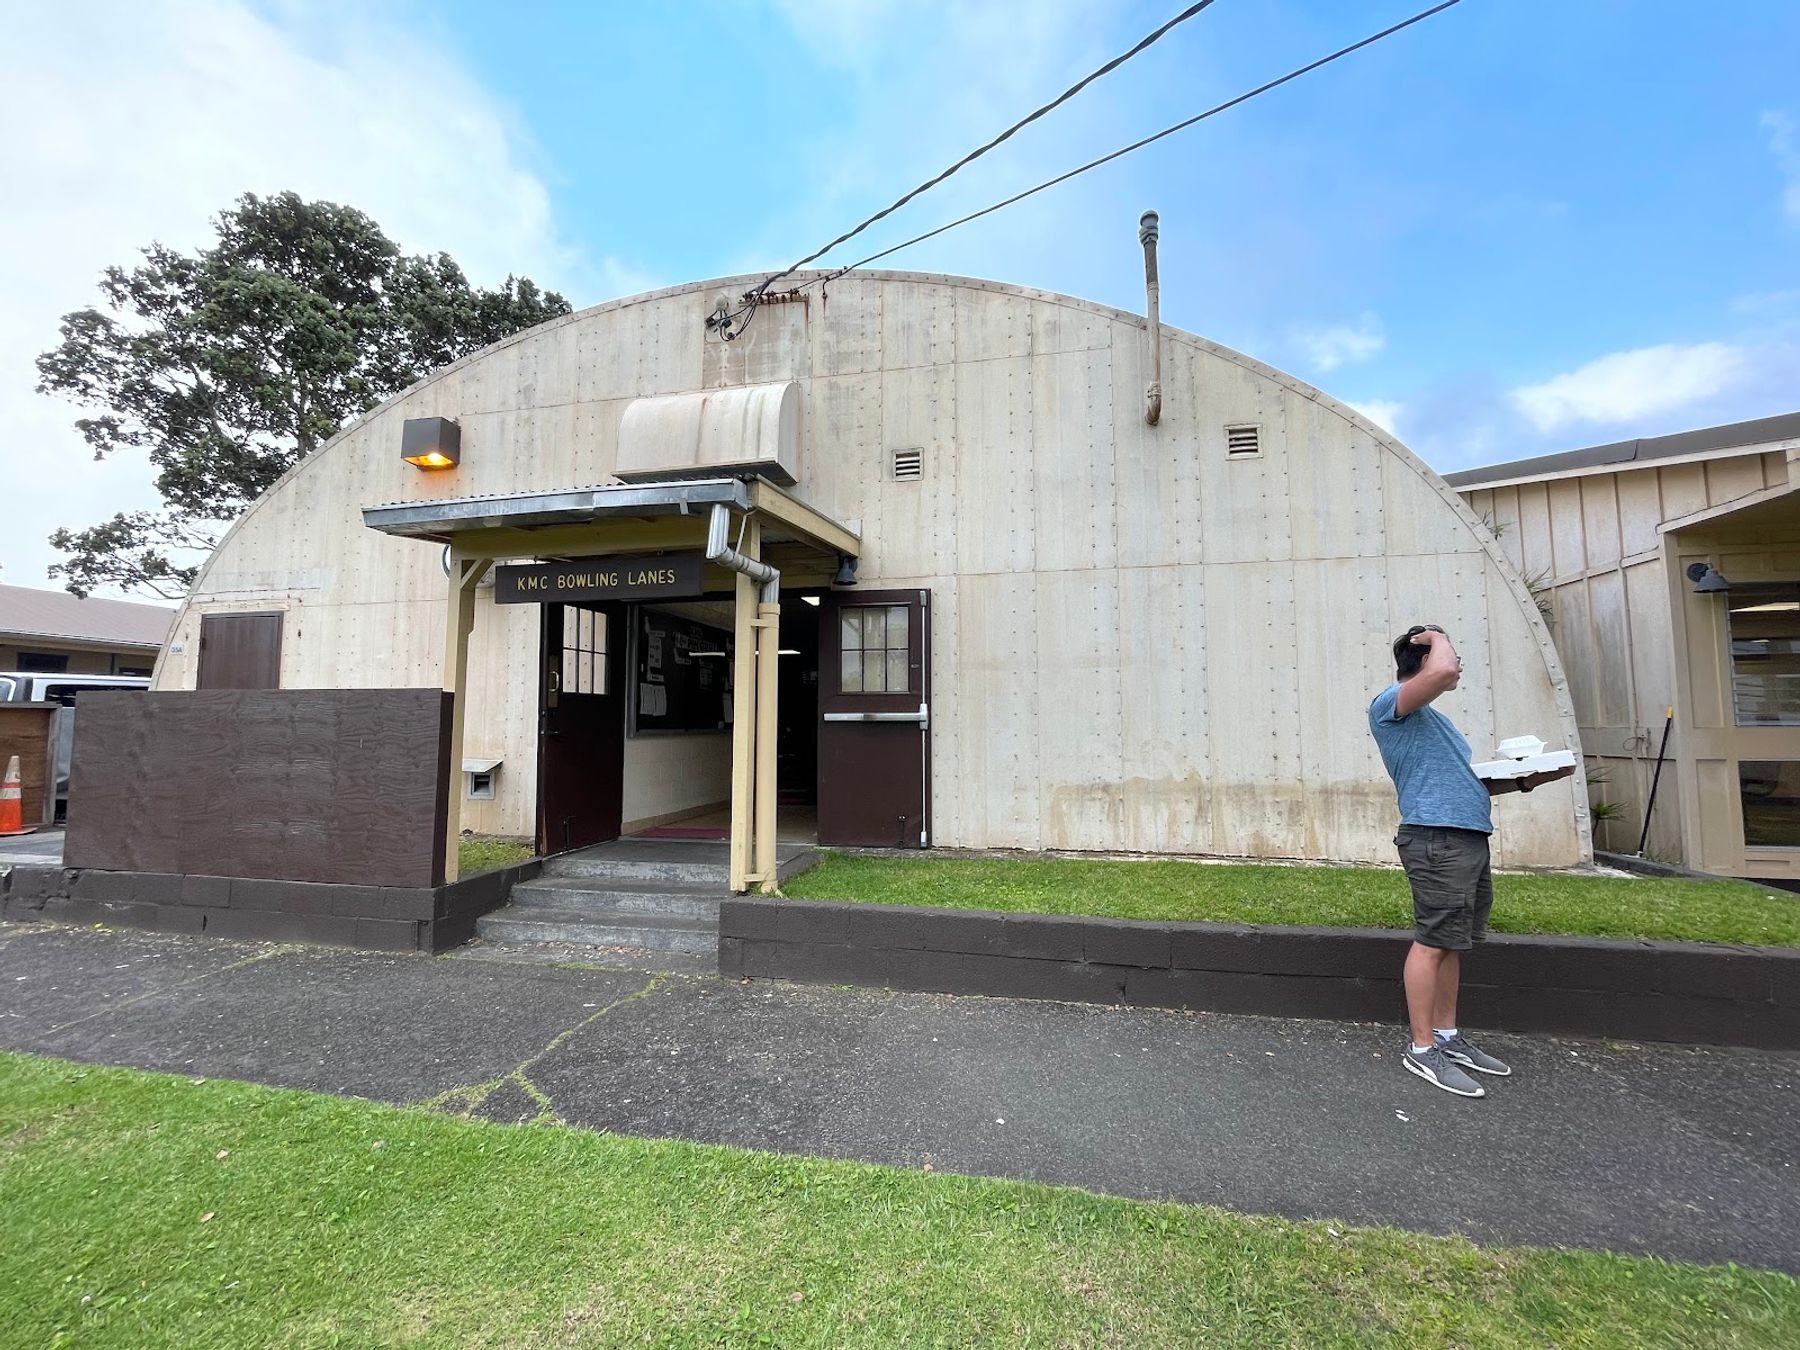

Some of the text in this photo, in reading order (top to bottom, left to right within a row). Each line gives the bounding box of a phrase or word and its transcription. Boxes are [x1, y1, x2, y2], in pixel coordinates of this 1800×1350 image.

[517, 569, 676, 591] KMC BOWLING LANES
